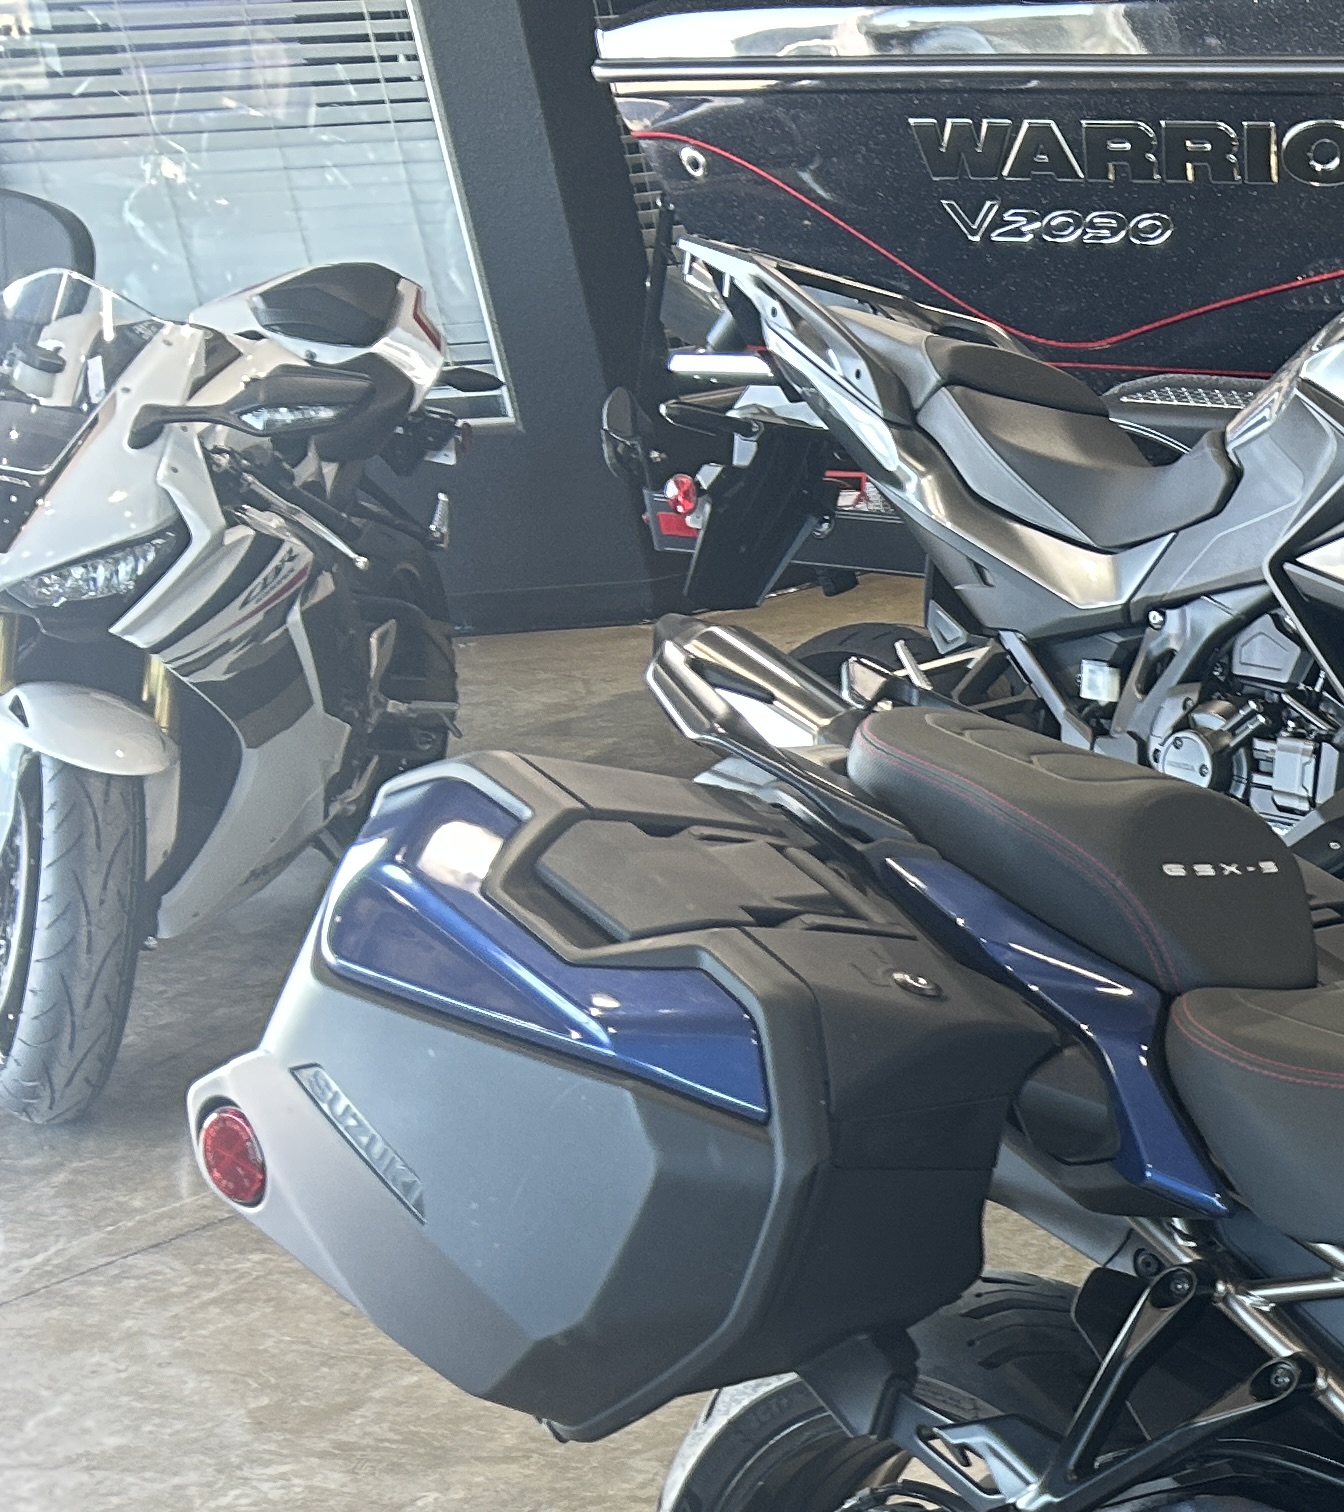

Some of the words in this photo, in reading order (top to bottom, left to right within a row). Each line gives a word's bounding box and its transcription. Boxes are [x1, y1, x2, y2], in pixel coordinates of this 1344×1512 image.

[940, 199, 1175, 245] V2090
[1162, 860, 1279, 877] GSX-S
[308, 1069, 424, 1204] SUZUKI
